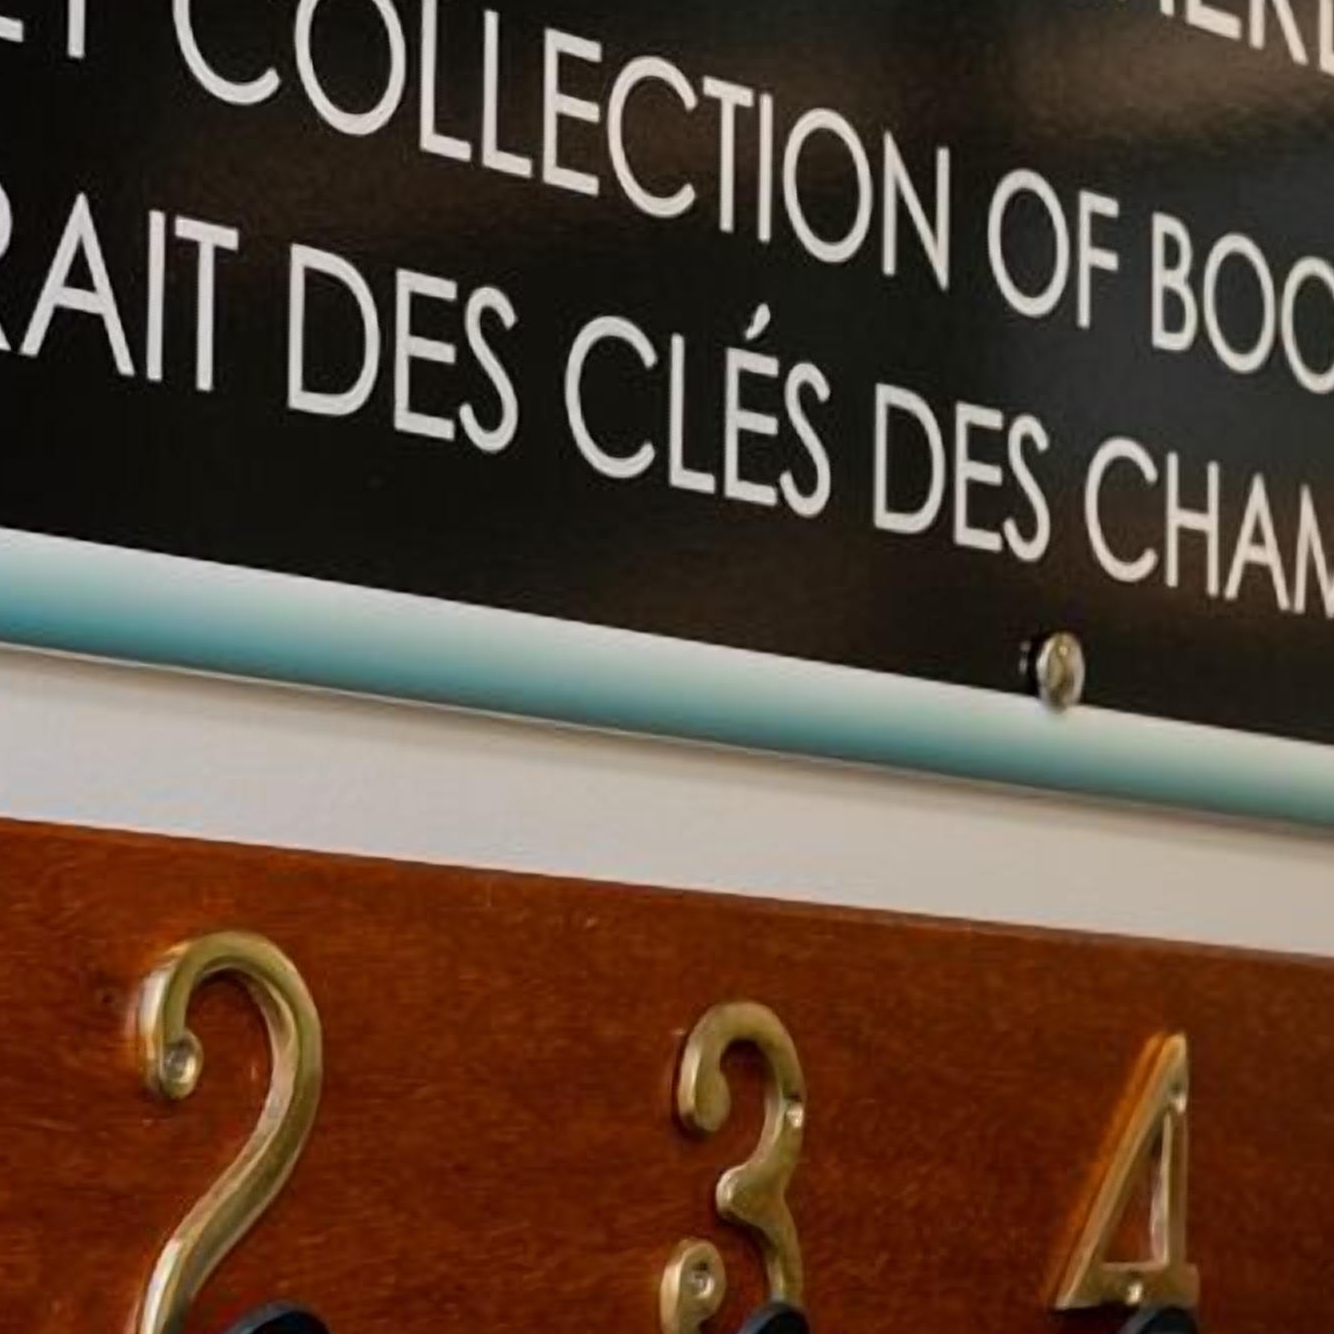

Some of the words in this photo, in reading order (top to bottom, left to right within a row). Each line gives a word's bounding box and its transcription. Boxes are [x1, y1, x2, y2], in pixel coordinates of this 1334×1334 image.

[986, 168, 1120, 329] OF
[287, 242, 519, 453] DES
[564, 302, 832, 518] CLÉS
[873, 382, 1051, 562] DES
[1051, 1031, 1199, 1309] 4
